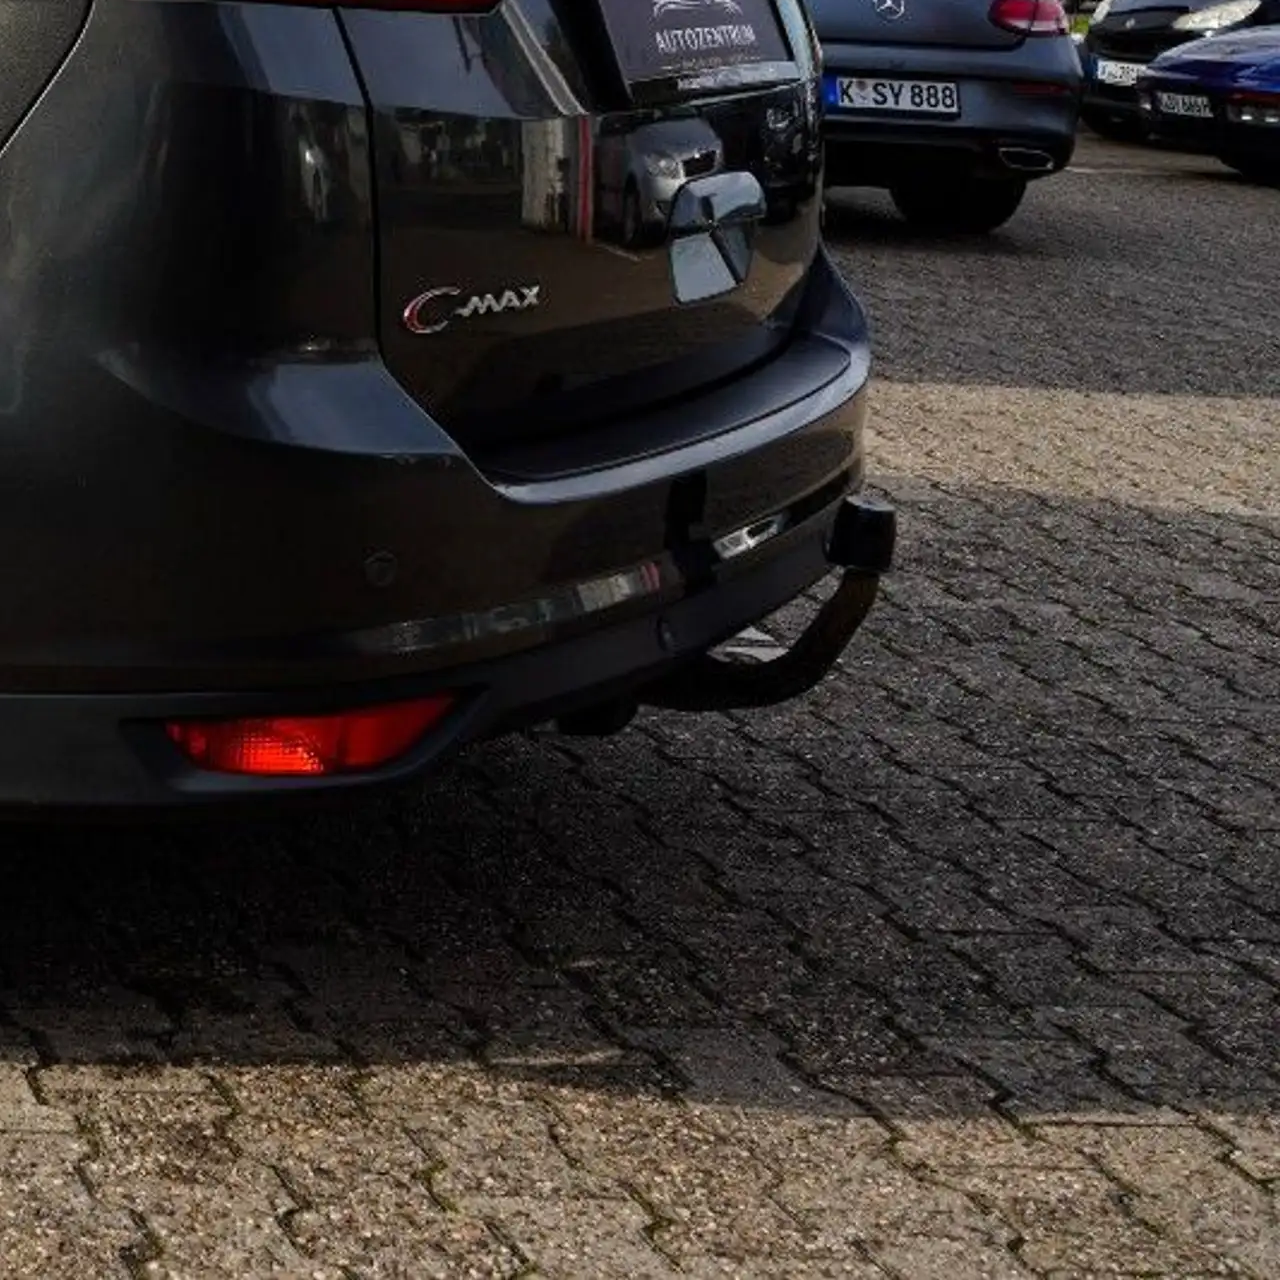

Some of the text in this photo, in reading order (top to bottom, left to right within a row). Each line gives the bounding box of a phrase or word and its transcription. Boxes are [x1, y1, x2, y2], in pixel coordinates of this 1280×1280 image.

[654, 23, 757, 54] AUTOZENTRUM
[839, 79, 955, 109] K SY 888
